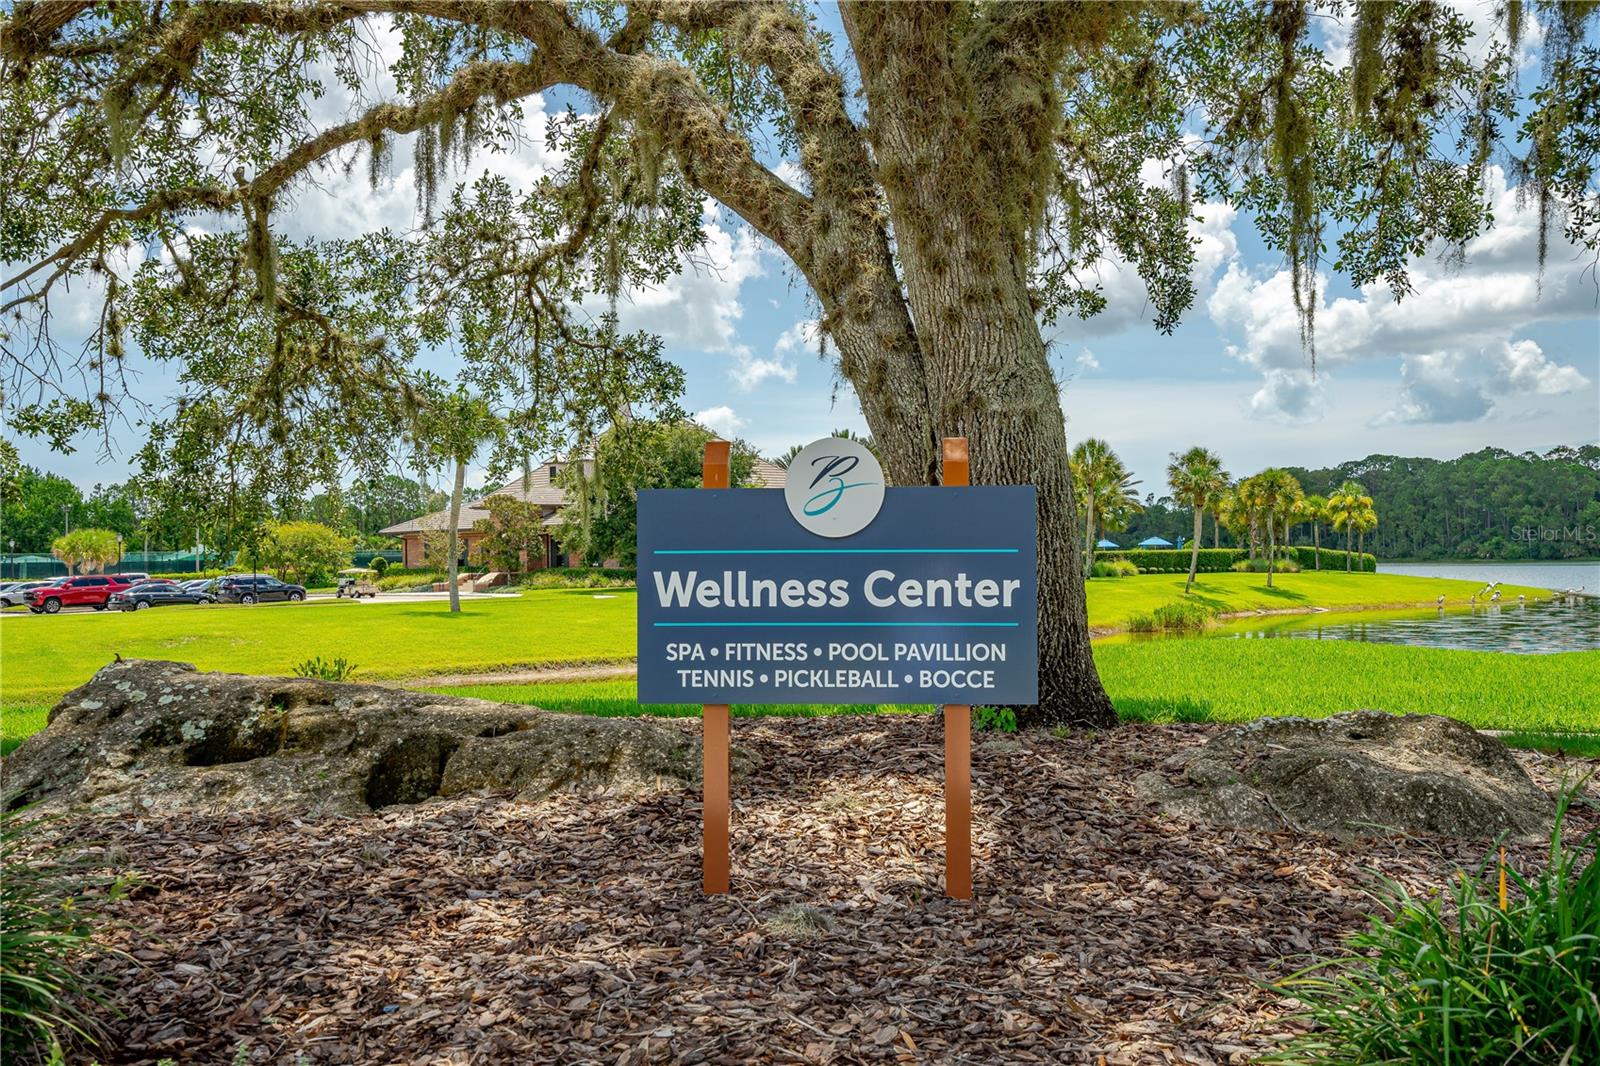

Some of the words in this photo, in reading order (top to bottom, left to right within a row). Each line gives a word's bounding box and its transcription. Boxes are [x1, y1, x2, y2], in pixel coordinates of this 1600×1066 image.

[653, 570, 849, 608] Wellness
[864, 569, 1020, 608] Center
[666, 642, 706, 662] SPA
[725, 642, 808, 662] FITNESS
[828, 642, 890, 662] POOL
[894, 642, 1006, 662] PAVILLION
[676, 669, 755, 688] TENNIS
[774, 669, 900, 688] PICKLEBALL
[919, 669, 996, 689] BOCCE
